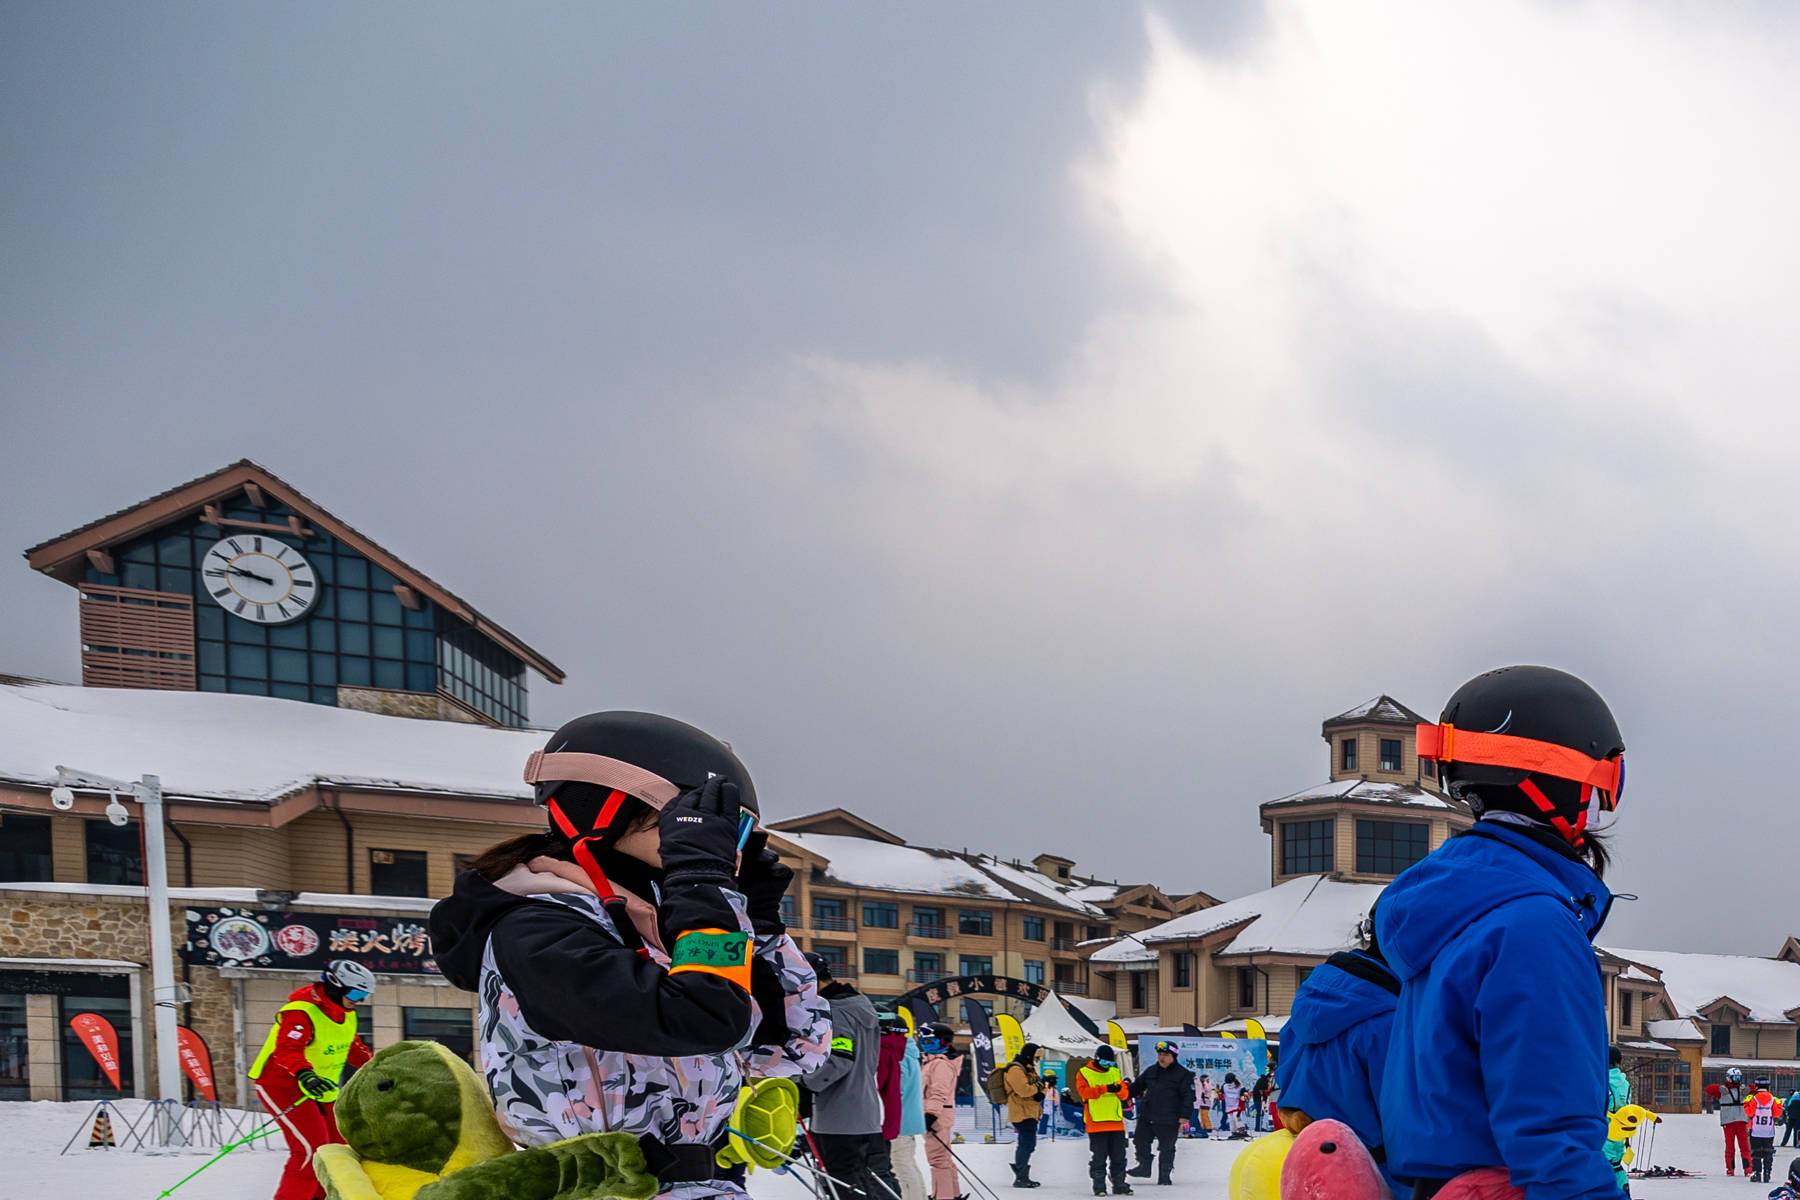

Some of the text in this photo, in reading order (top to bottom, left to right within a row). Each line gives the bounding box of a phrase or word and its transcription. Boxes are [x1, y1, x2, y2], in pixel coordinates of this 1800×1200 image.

[676, 816, 703, 824] WEDZE
[329, 922, 434, 957] 炭火烤
[1186, 1057, 1232, 1069] 冰雪嘉年华
